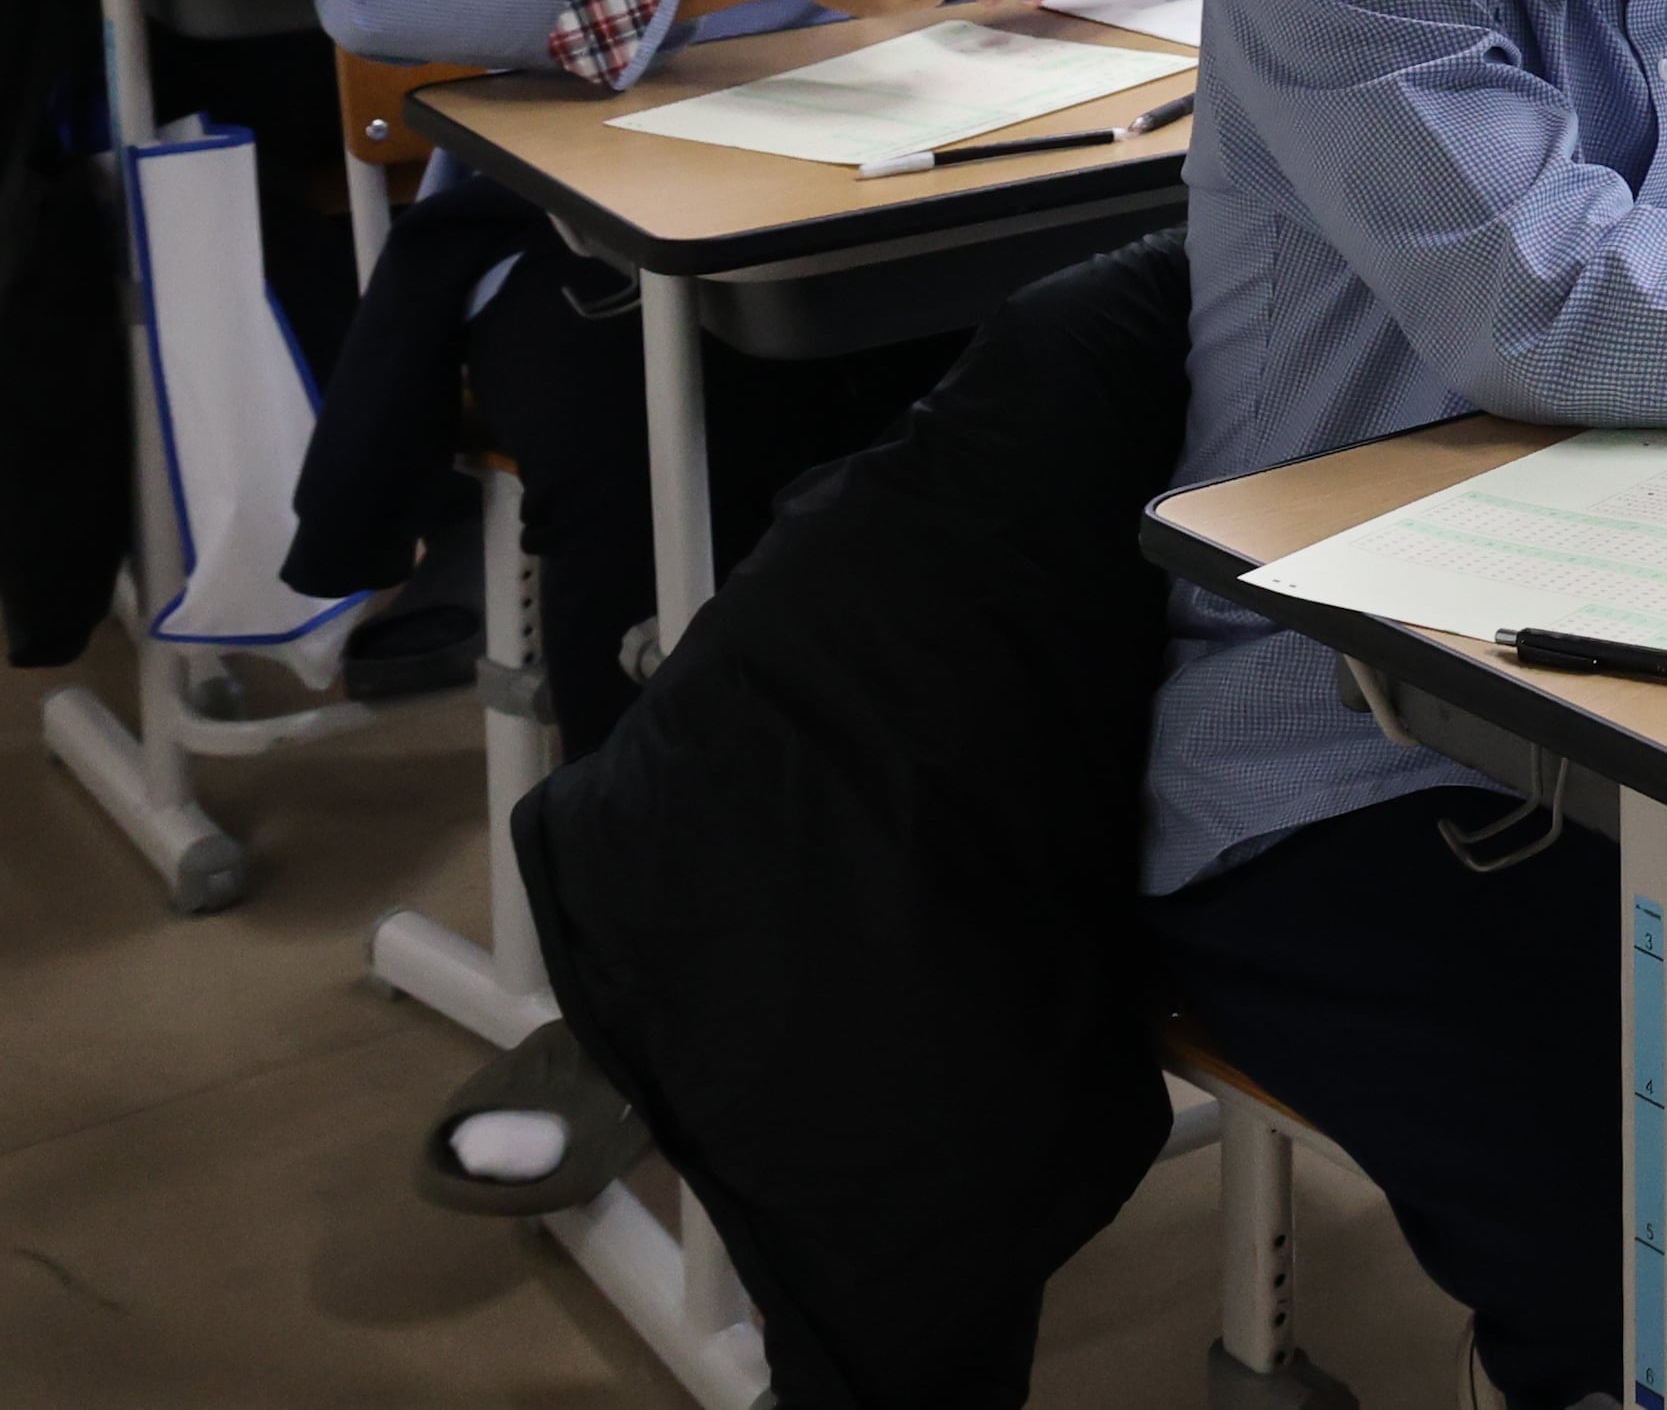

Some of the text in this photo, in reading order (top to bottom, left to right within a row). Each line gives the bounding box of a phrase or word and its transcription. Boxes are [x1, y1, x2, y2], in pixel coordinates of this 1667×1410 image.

[1645, 932, 1653, 951] 3
[1646, 1079, 1653, 1095] 4
[1646, 1222, 1654, 1241] 5
[1646, 1367, 1655, 1385] 6
